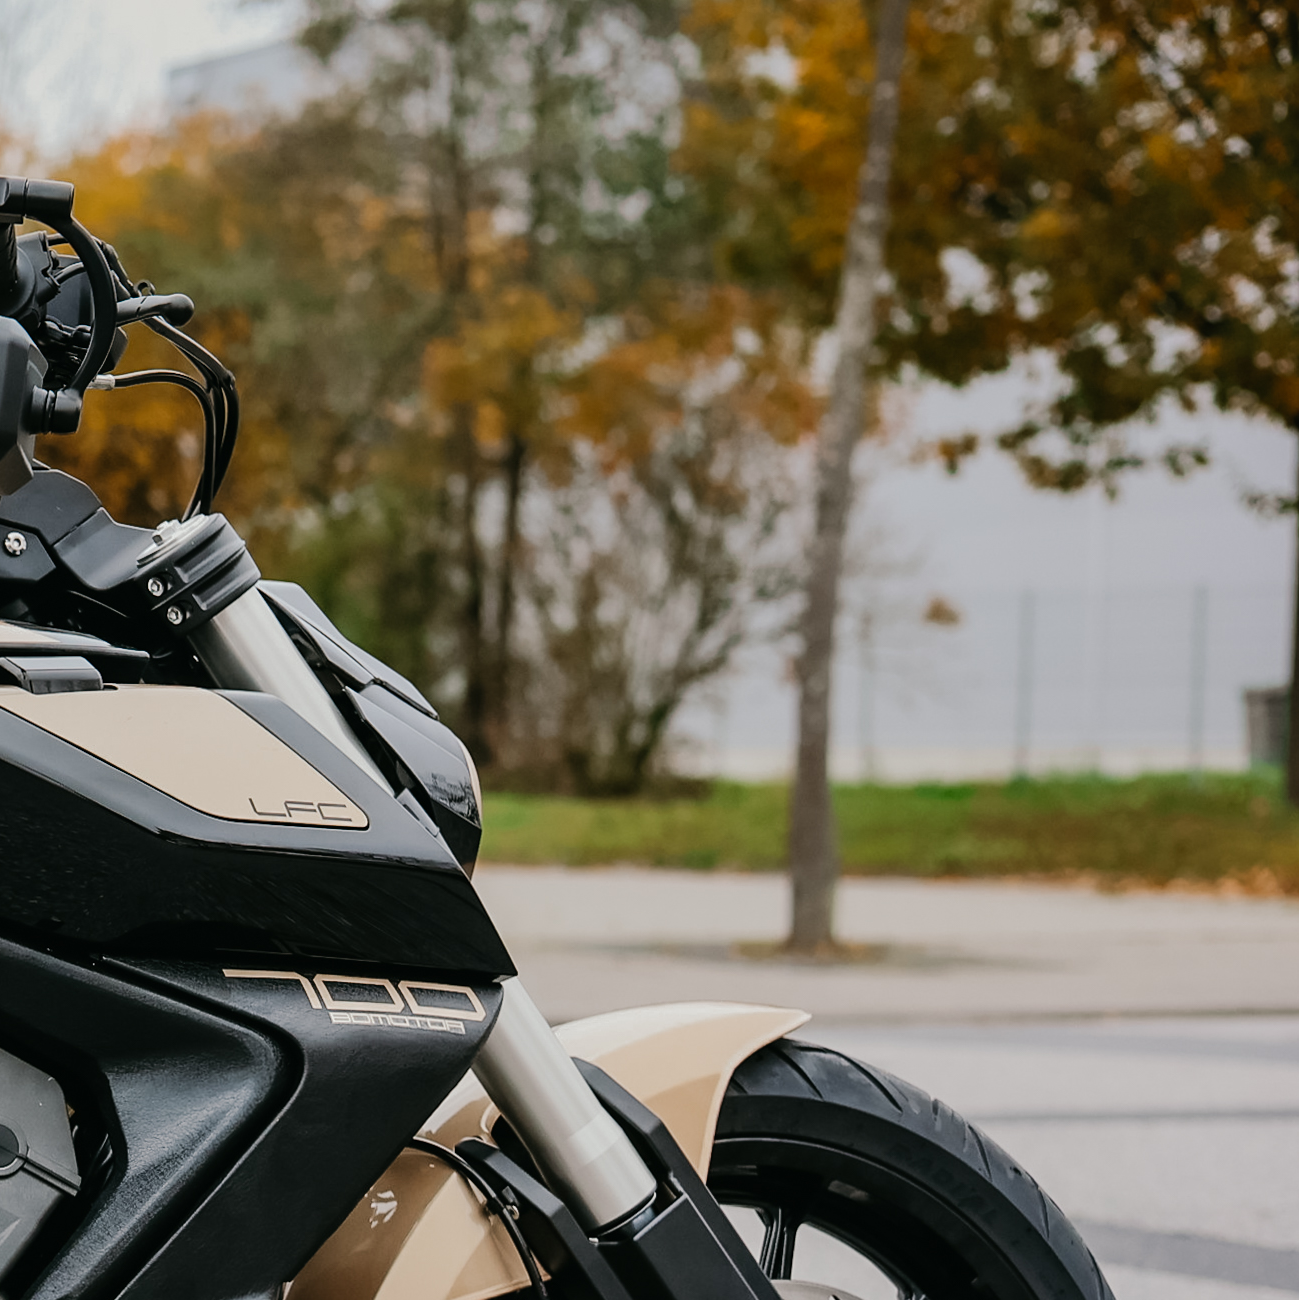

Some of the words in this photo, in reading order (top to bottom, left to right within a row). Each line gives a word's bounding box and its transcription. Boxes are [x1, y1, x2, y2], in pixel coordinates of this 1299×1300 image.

[249, 798, 352, 822] LFC
[222, 969, 486, 1021] 700
[329, 1012, 465, 1034] BOMOTOR
